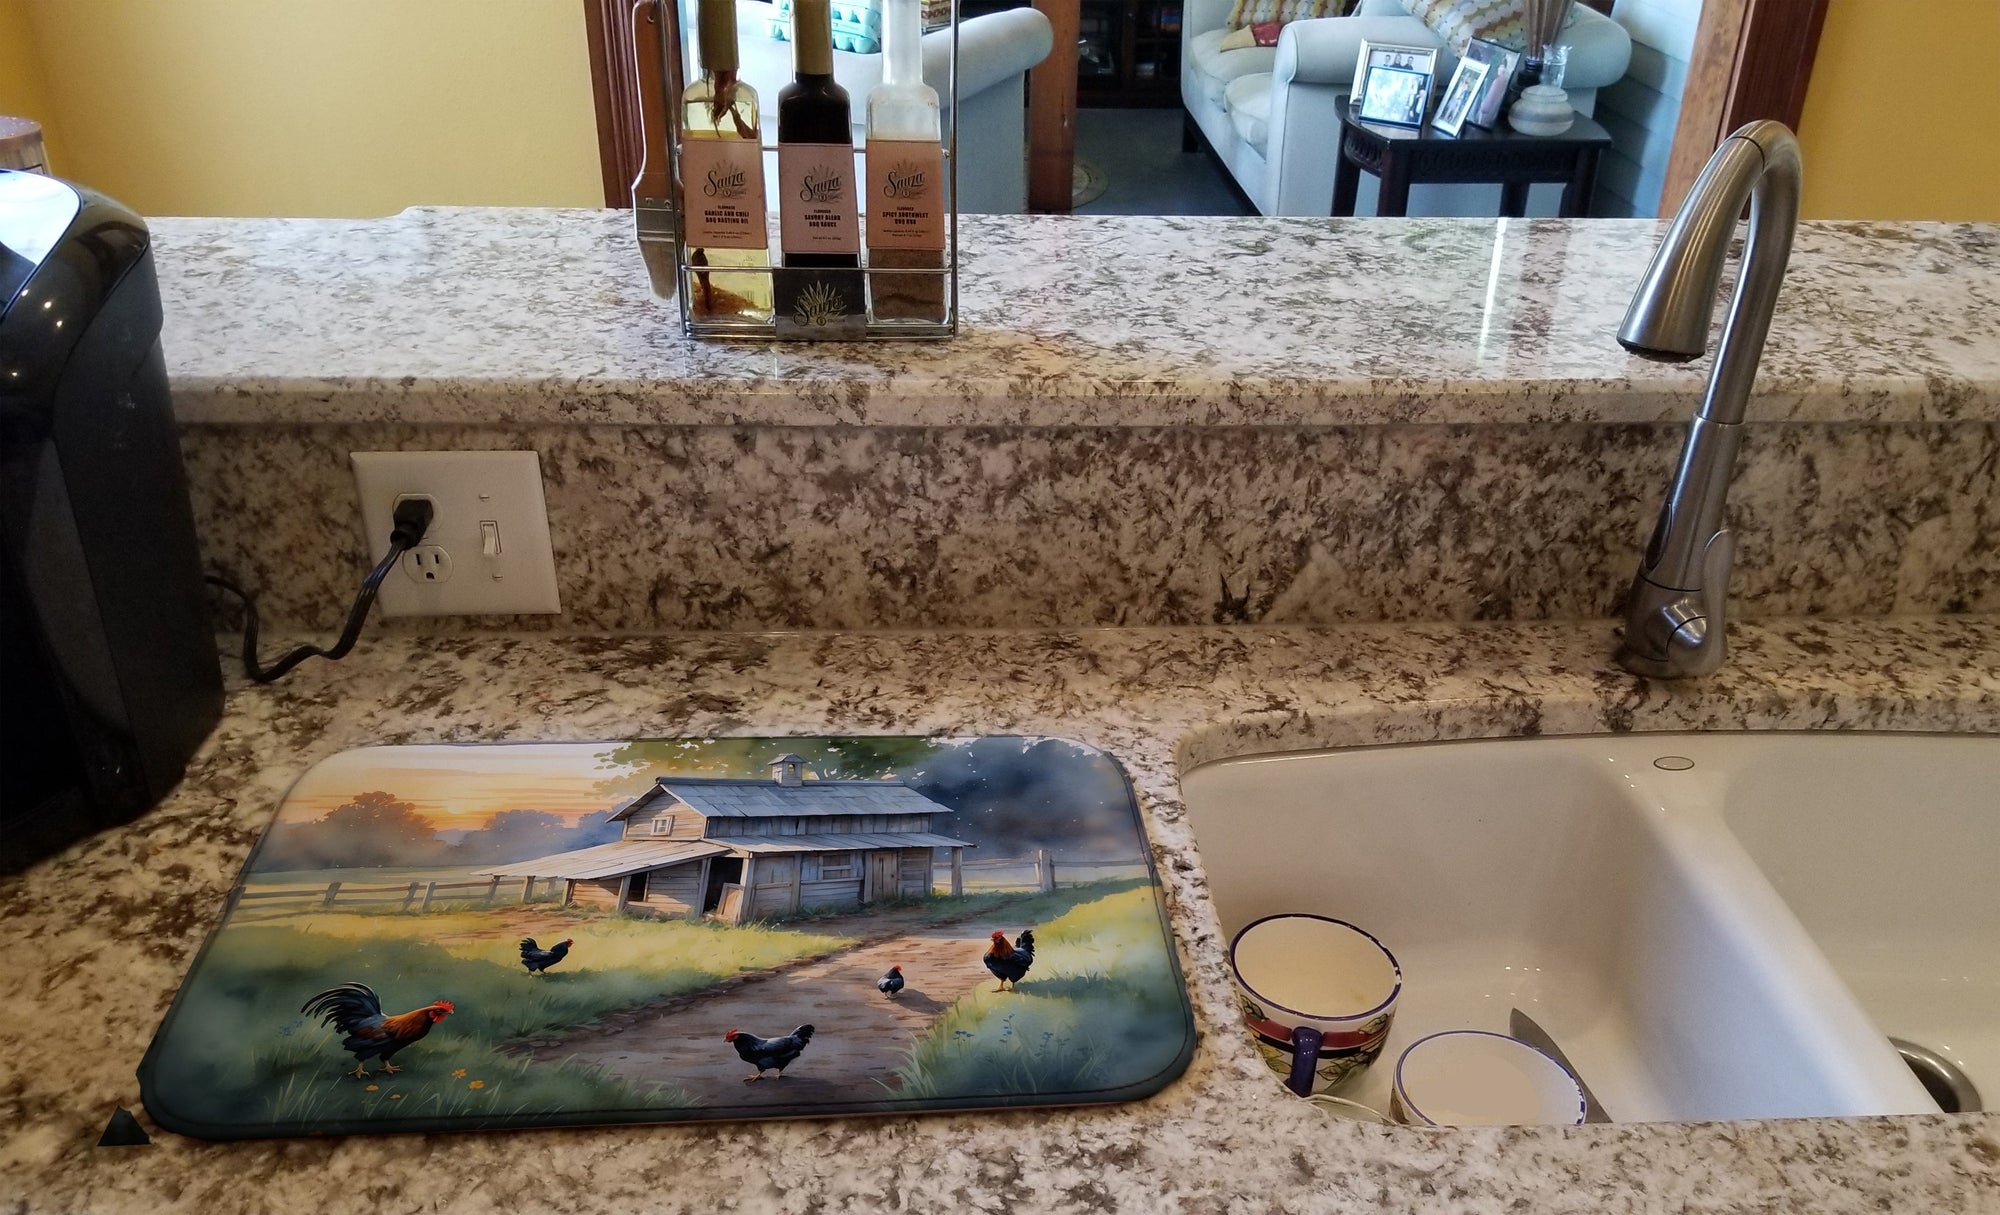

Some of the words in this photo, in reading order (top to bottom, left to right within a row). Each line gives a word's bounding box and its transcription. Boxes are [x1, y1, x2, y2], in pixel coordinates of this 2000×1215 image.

[704, 170, 745, 197] Sauza
[800, 175, 842, 202] Sauza
[883, 171, 925, 198] Sauza
